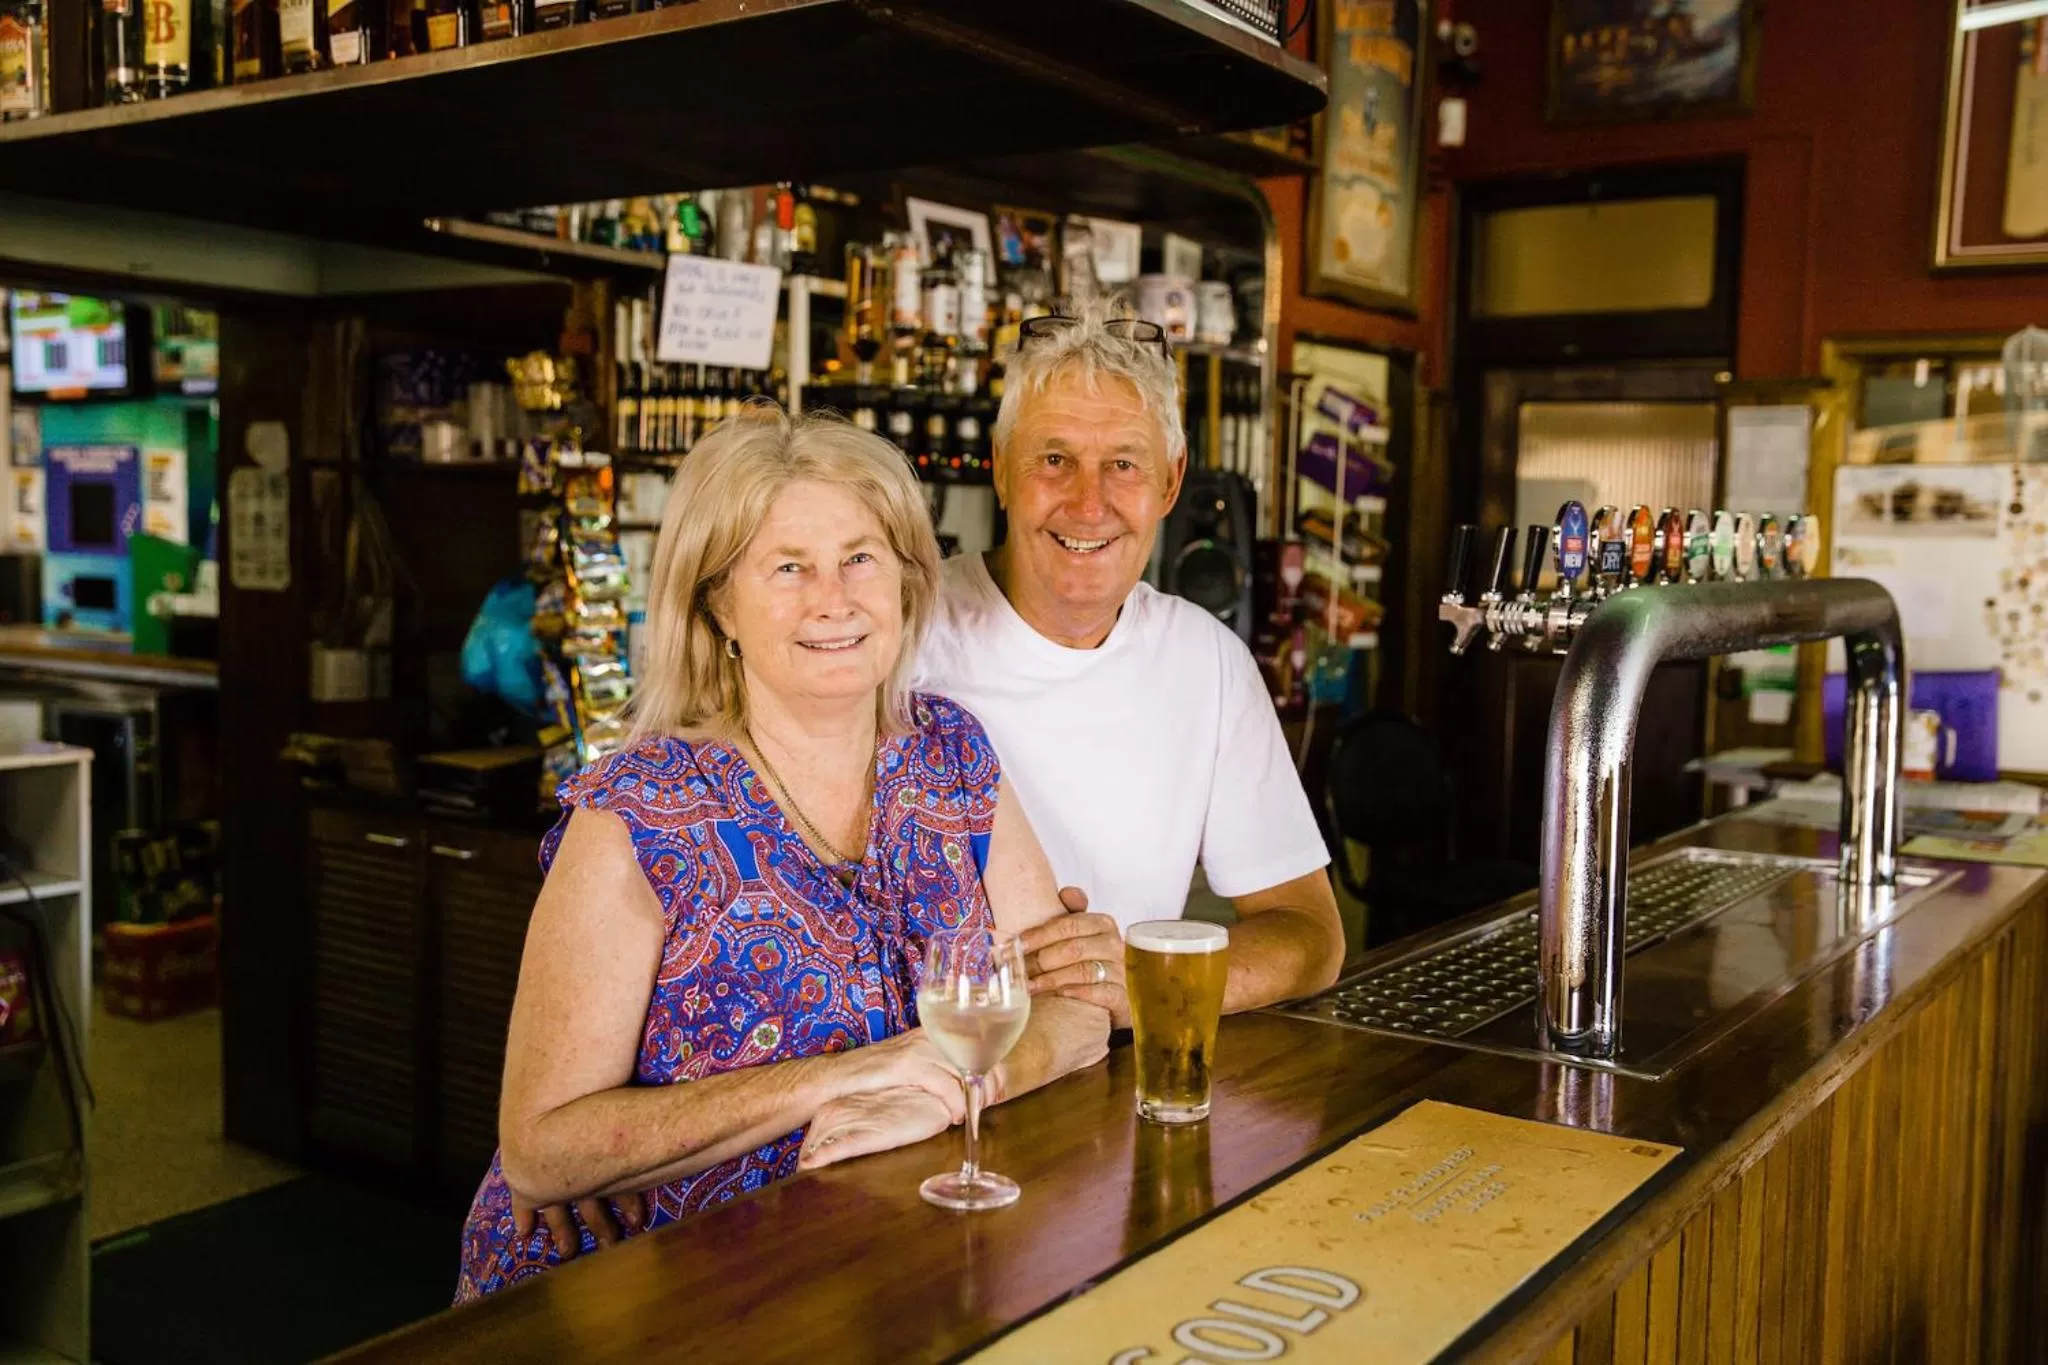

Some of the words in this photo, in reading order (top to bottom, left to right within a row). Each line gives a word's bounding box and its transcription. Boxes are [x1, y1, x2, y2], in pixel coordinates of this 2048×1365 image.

[1564, 553, 1583, 568] NEW
[1602, 551, 1622, 569] DRY
[1111, 1266, 1361, 1365] OLD
